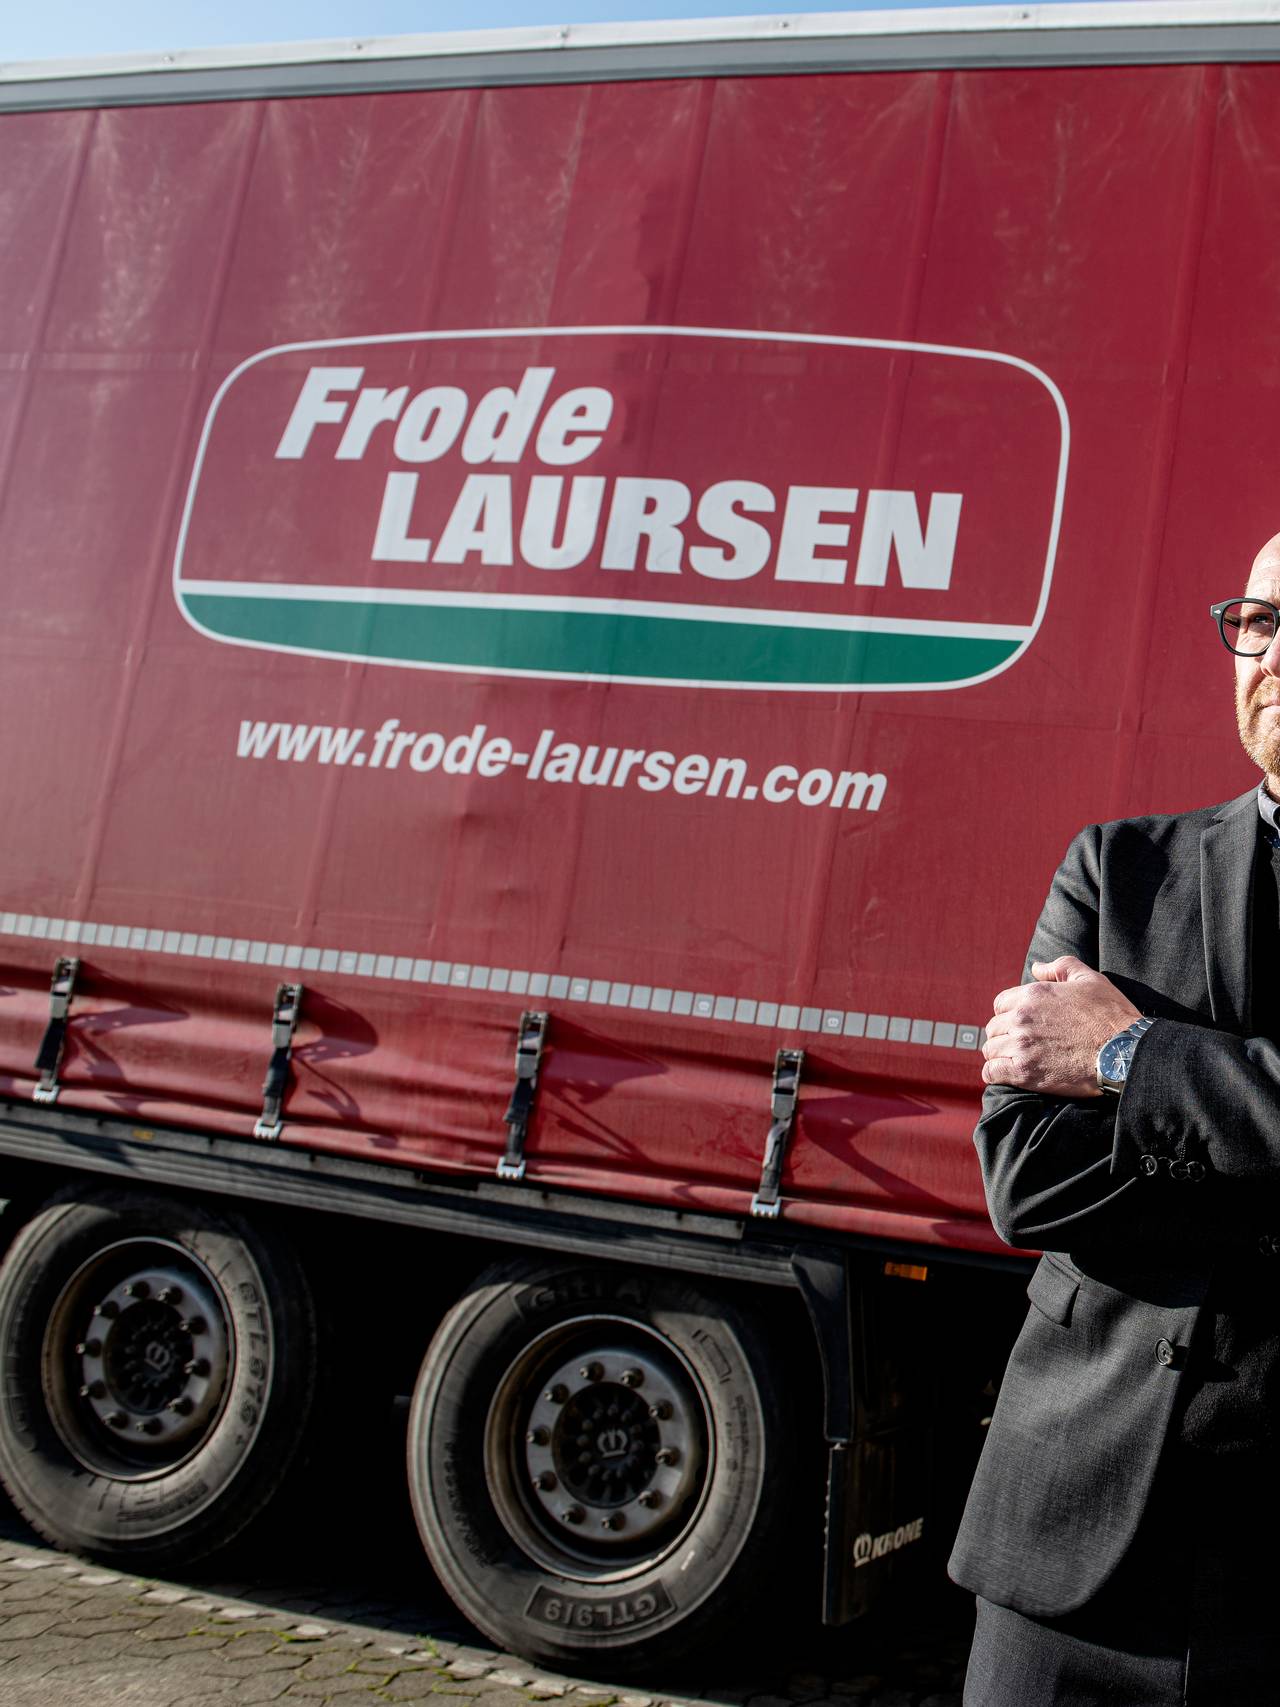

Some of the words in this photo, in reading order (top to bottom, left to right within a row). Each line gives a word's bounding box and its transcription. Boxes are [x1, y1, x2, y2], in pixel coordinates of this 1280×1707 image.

[274, 367, 614, 466] Frode
[371, 471, 963, 590] LAURSEN
[236, 718, 887, 811] www.frode-laursen.com
[871, 1516, 925, 1560] KRONE
